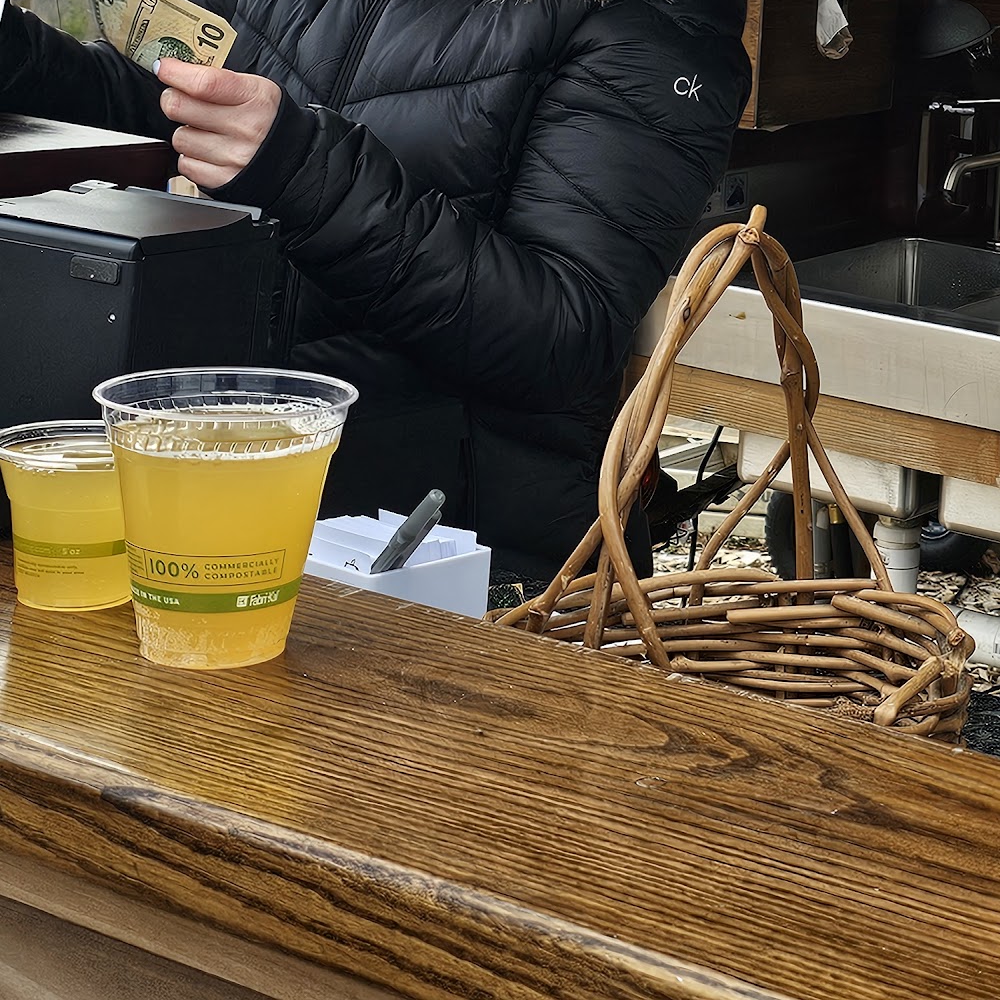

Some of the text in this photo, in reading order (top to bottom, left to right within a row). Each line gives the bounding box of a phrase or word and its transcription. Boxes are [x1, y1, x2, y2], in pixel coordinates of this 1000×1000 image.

[196, 23, 226, 50] 10
[149, 557, 200, 580] 100%
[204, 557, 280, 571] COMMERCIALLY
[204, 566, 277, 580] COMPOSTABLE
[163, 596, 180, 606] USA
